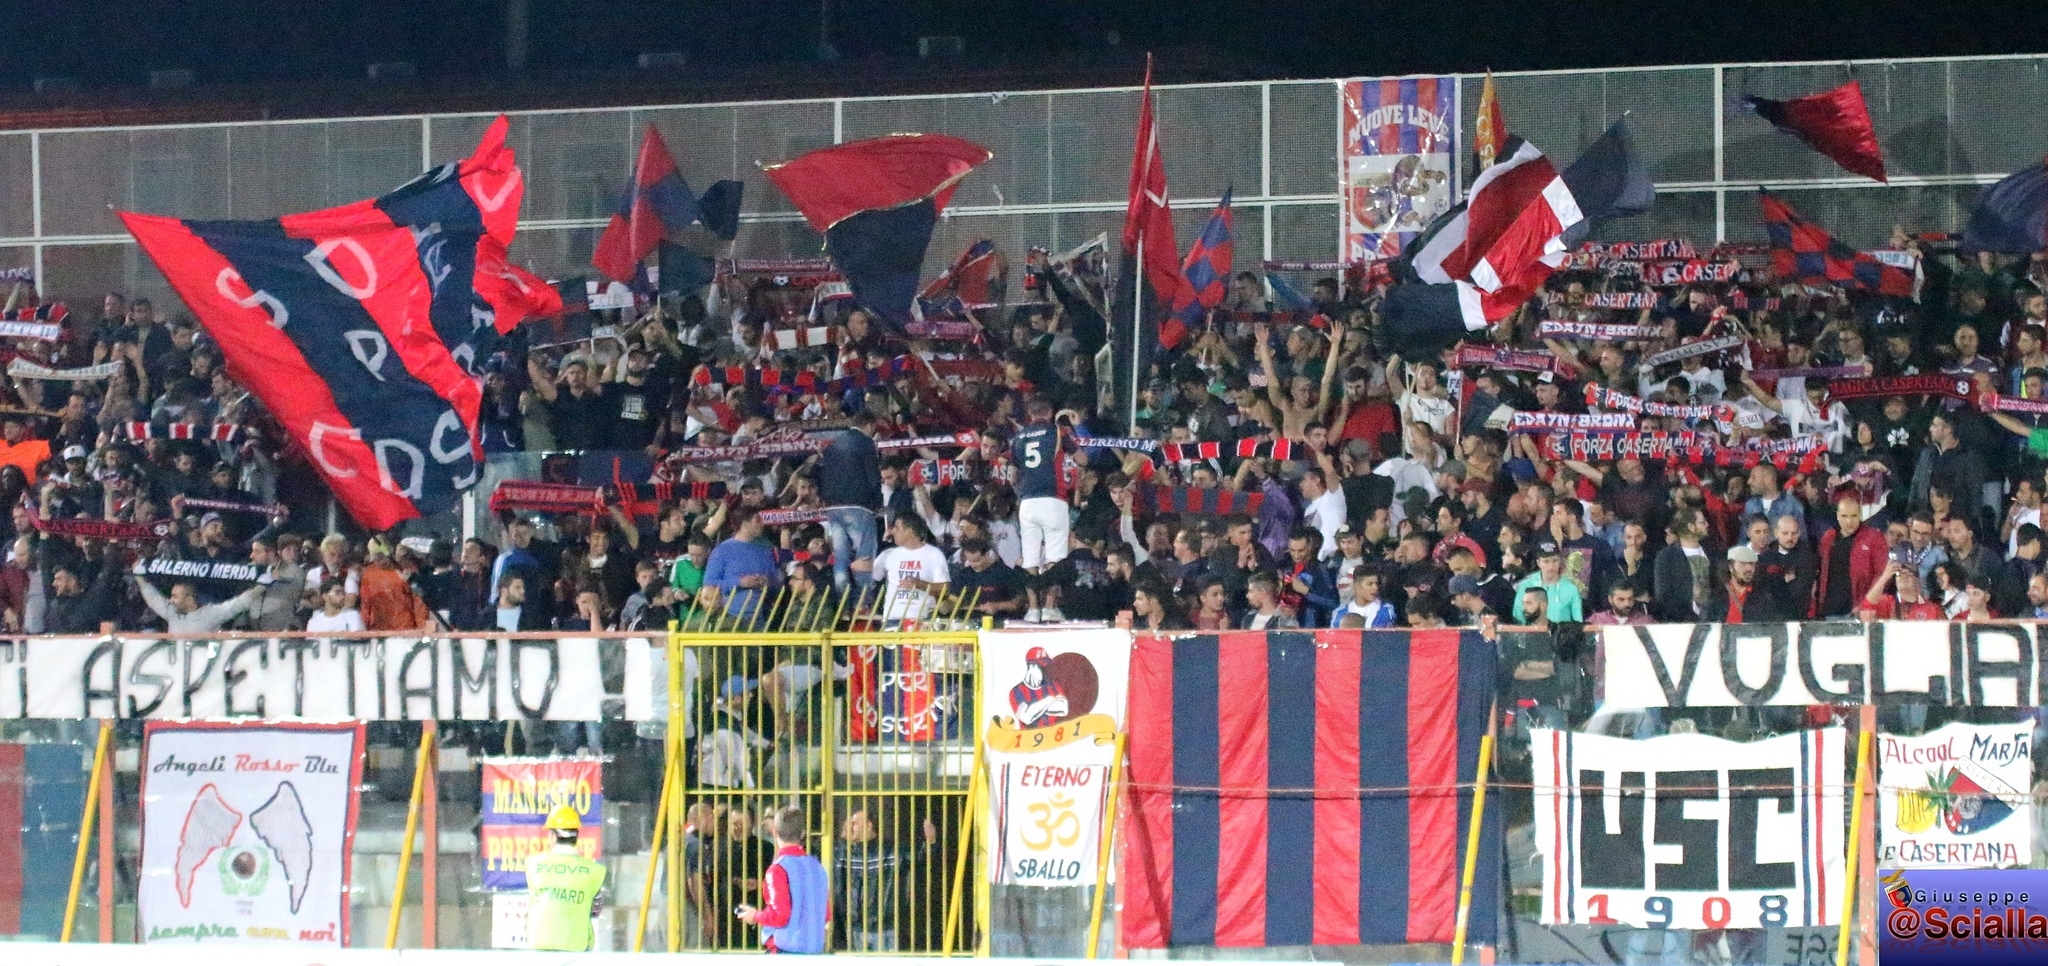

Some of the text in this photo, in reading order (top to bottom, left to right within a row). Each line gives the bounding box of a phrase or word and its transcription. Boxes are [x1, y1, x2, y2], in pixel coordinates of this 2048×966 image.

[1349, 105, 1404, 148] NUOVE
[1610, 239, 1697, 259] CASERTANA
[1585, 291, 1657, 308] CASERTANA
[1024, 441, 1042, 469] 5
[1574, 436, 1614, 454] FORZA
[149, 559, 257, 581] SALERNO MERDA
[1014, 720, 1083, 748] 1981
[153, 754, 339, 777] Angeli Rosso Blu
[1021, 765, 1092, 788] ETERNO
[493, 778, 591, 816] MANESCO
[1579, 767, 1796, 892] USC
[1899, 839, 2019, 864] CASERTANA
[1015, 858, 1081, 881] SBALLO
[1587, 894, 1789, 929] 1908
[148, 922, 337, 942] sempre con noi
